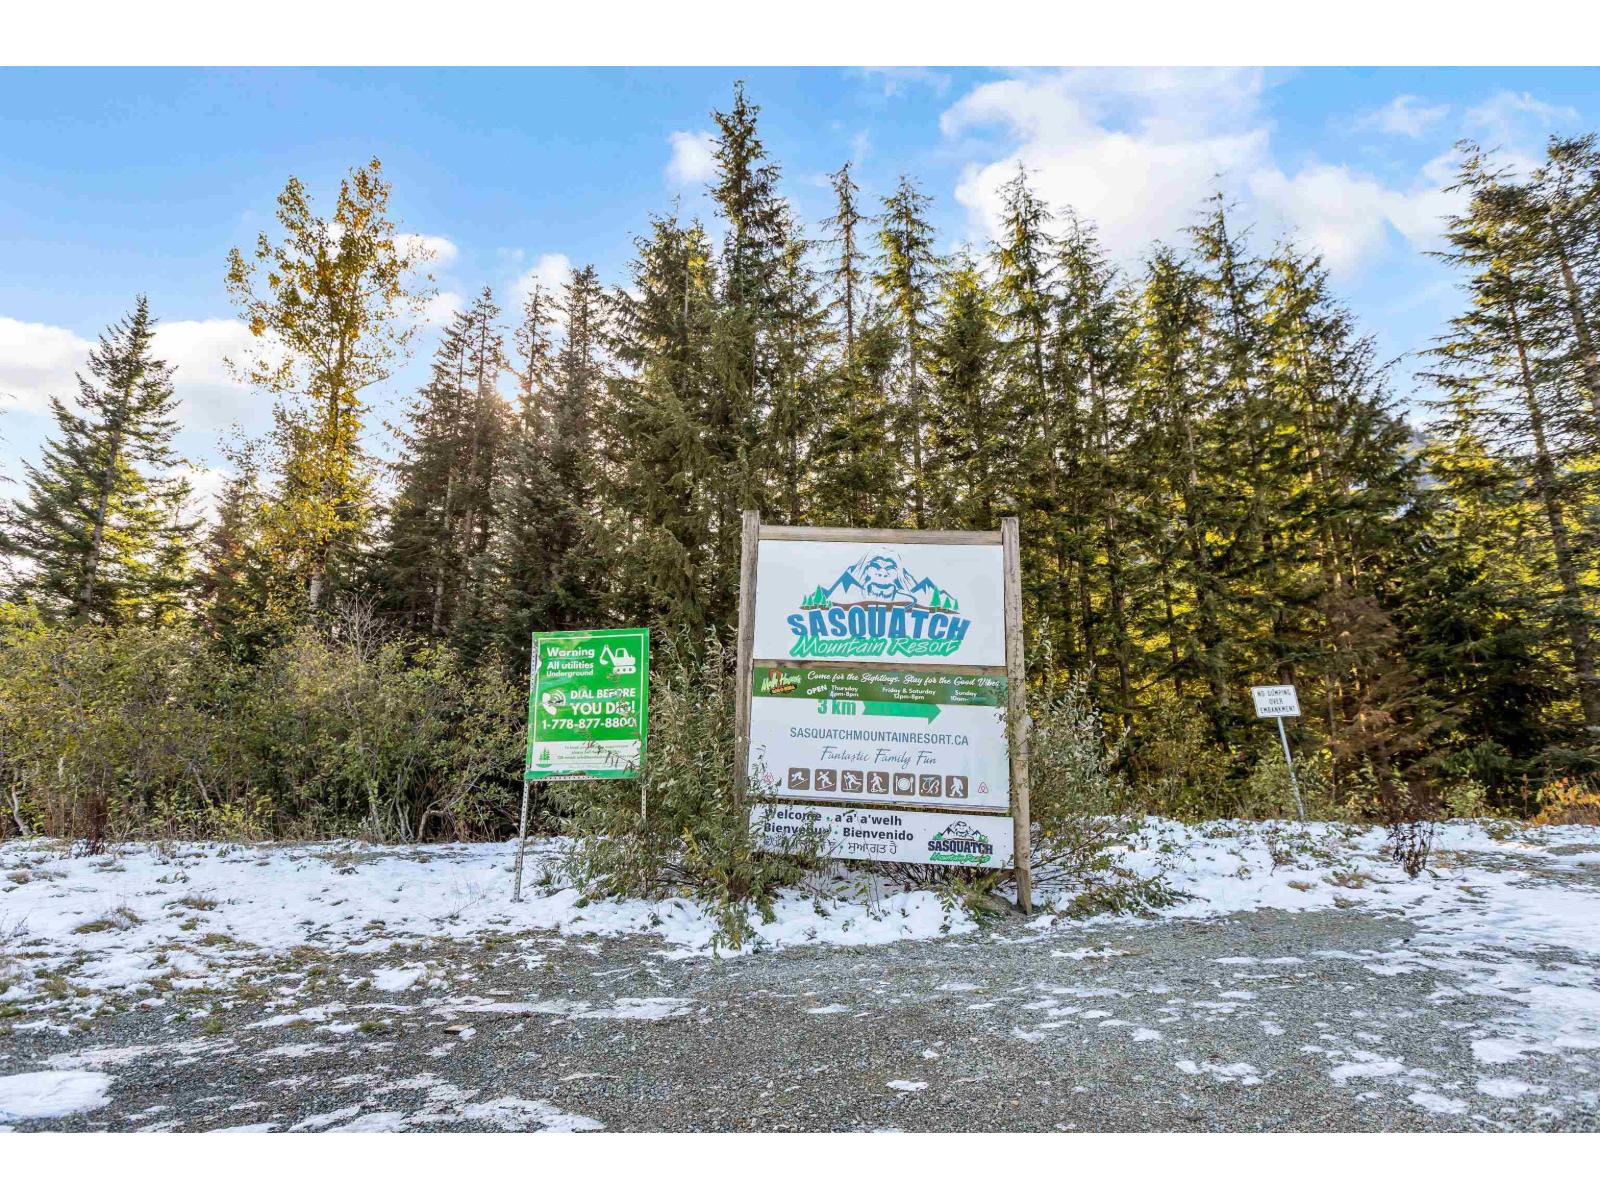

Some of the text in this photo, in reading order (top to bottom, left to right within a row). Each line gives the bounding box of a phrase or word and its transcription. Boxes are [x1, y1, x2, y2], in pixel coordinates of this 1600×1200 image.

[786, 604, 971, 640] SASQUATCH
[546, 647, 595, 658] Warning
[793, 636, 960, 656] Mountain Resort
[546, 660, 594, 670] All utilities
[546, 669, 594, 678] Underground
[807, 671, 831, 680] Come
[831, 674, 845, 682] for
[904, 674, 923, 686] Stay
[923, 676, 937, 685] for
[939, 675, 951, 685] the
[954, 676, 976, 686] Good
[978, 677, 1001, 688] Vibes
[570, 688, 636, 699] DIAL BEFORE
[806, 684, 828, 695] OPEN
[831, 684, 859, 692] Thursday
[1267, 689, 1292, 697] DUMPING
[570, 701, 636, 715] YOU DIG!
[817, 699, 857, 716] 3 km
[542, 717, 637, 730] 1-778-877-8800
[790, 727, 970, 746] SASQUATCHMOUNTAINRESORT.CA
[820, 745, 937, 770] Fantastic Family Fun
[764, 822, 914, 841] Bienveu Bienvenido
[927, 840, 994, 855] SASQUATCH
